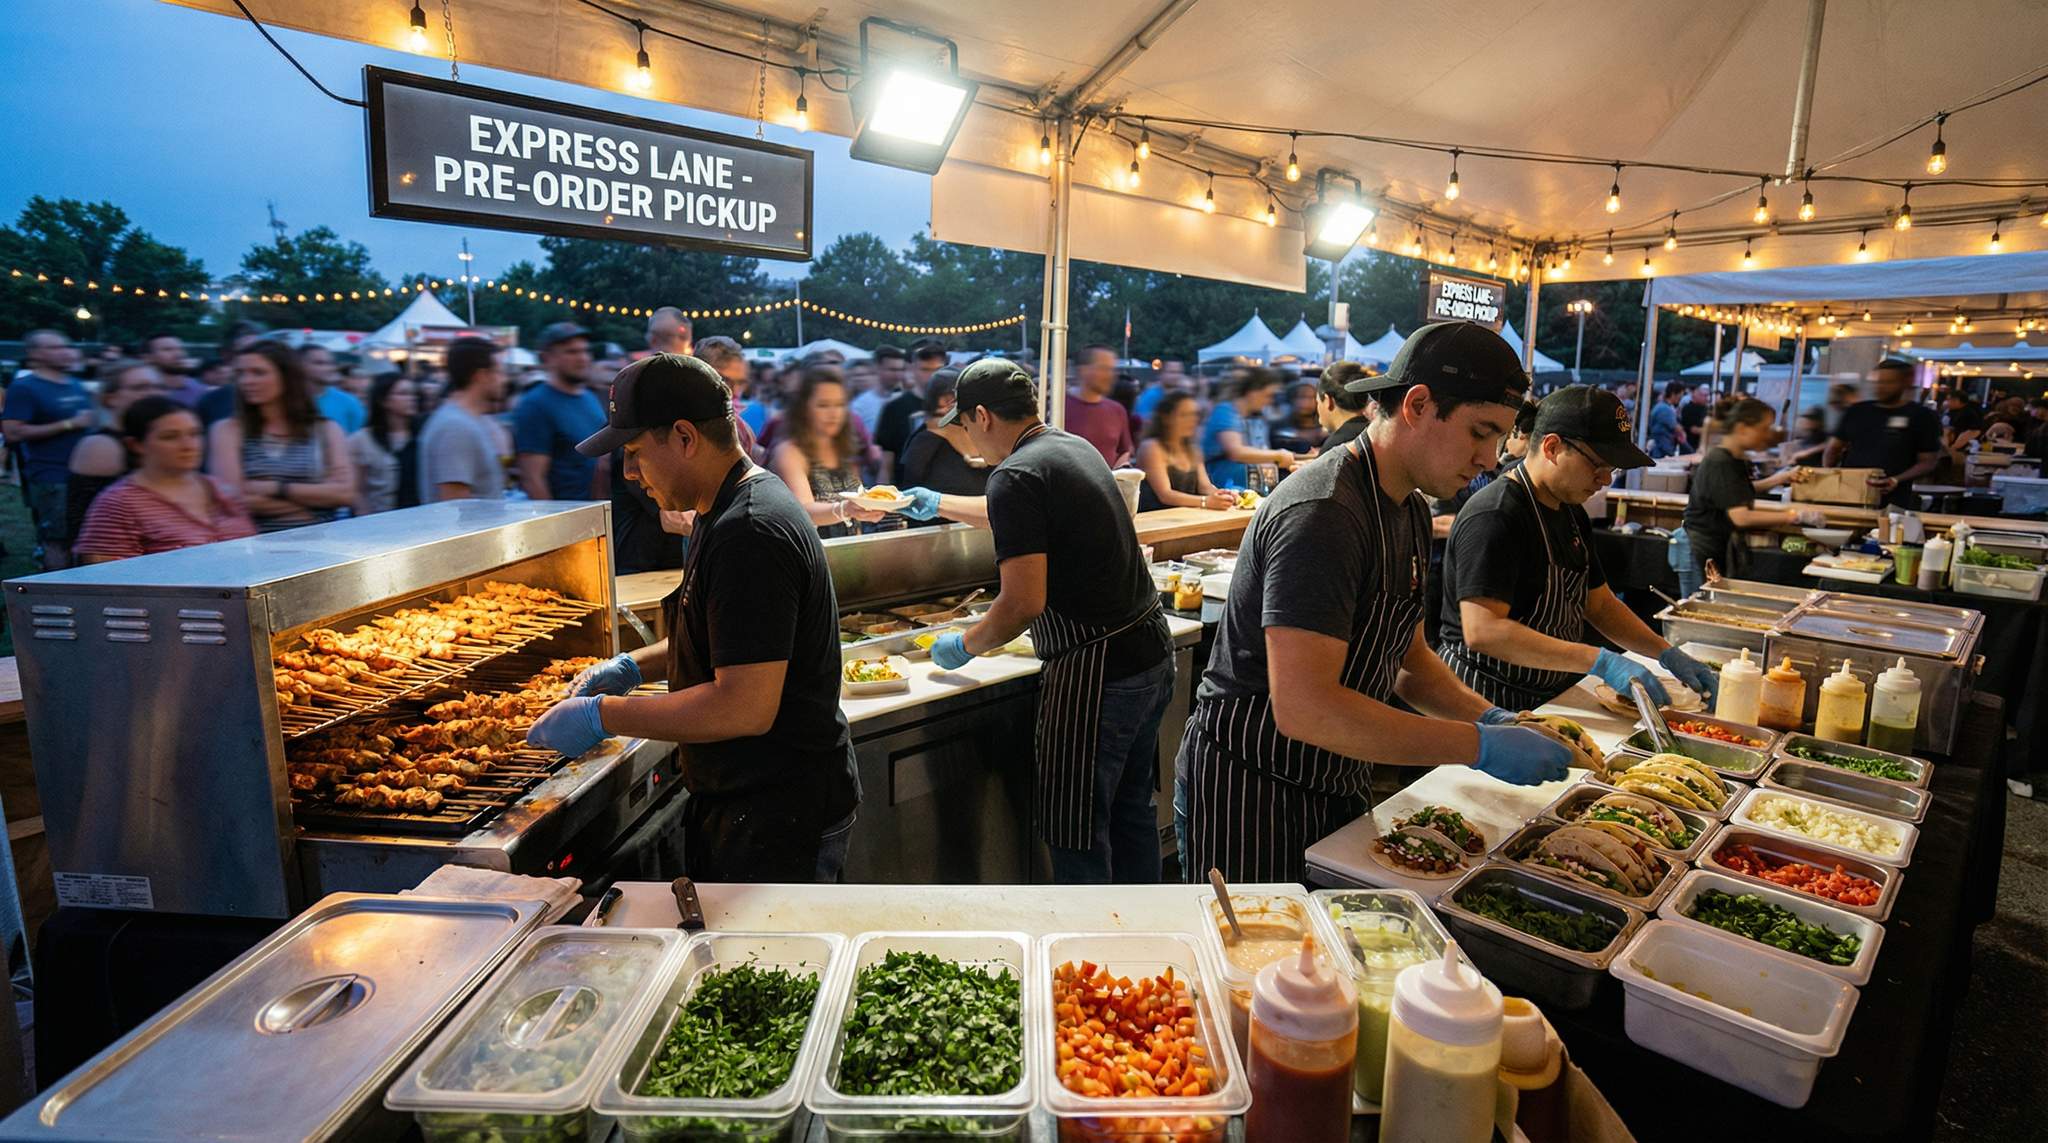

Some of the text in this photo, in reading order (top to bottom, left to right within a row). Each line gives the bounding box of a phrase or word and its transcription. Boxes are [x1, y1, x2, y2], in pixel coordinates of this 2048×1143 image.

[469, 115, 753, 190] EXPRESS LANE -
[434, 155, 777, 233] PRE-ORDER PICKUP
